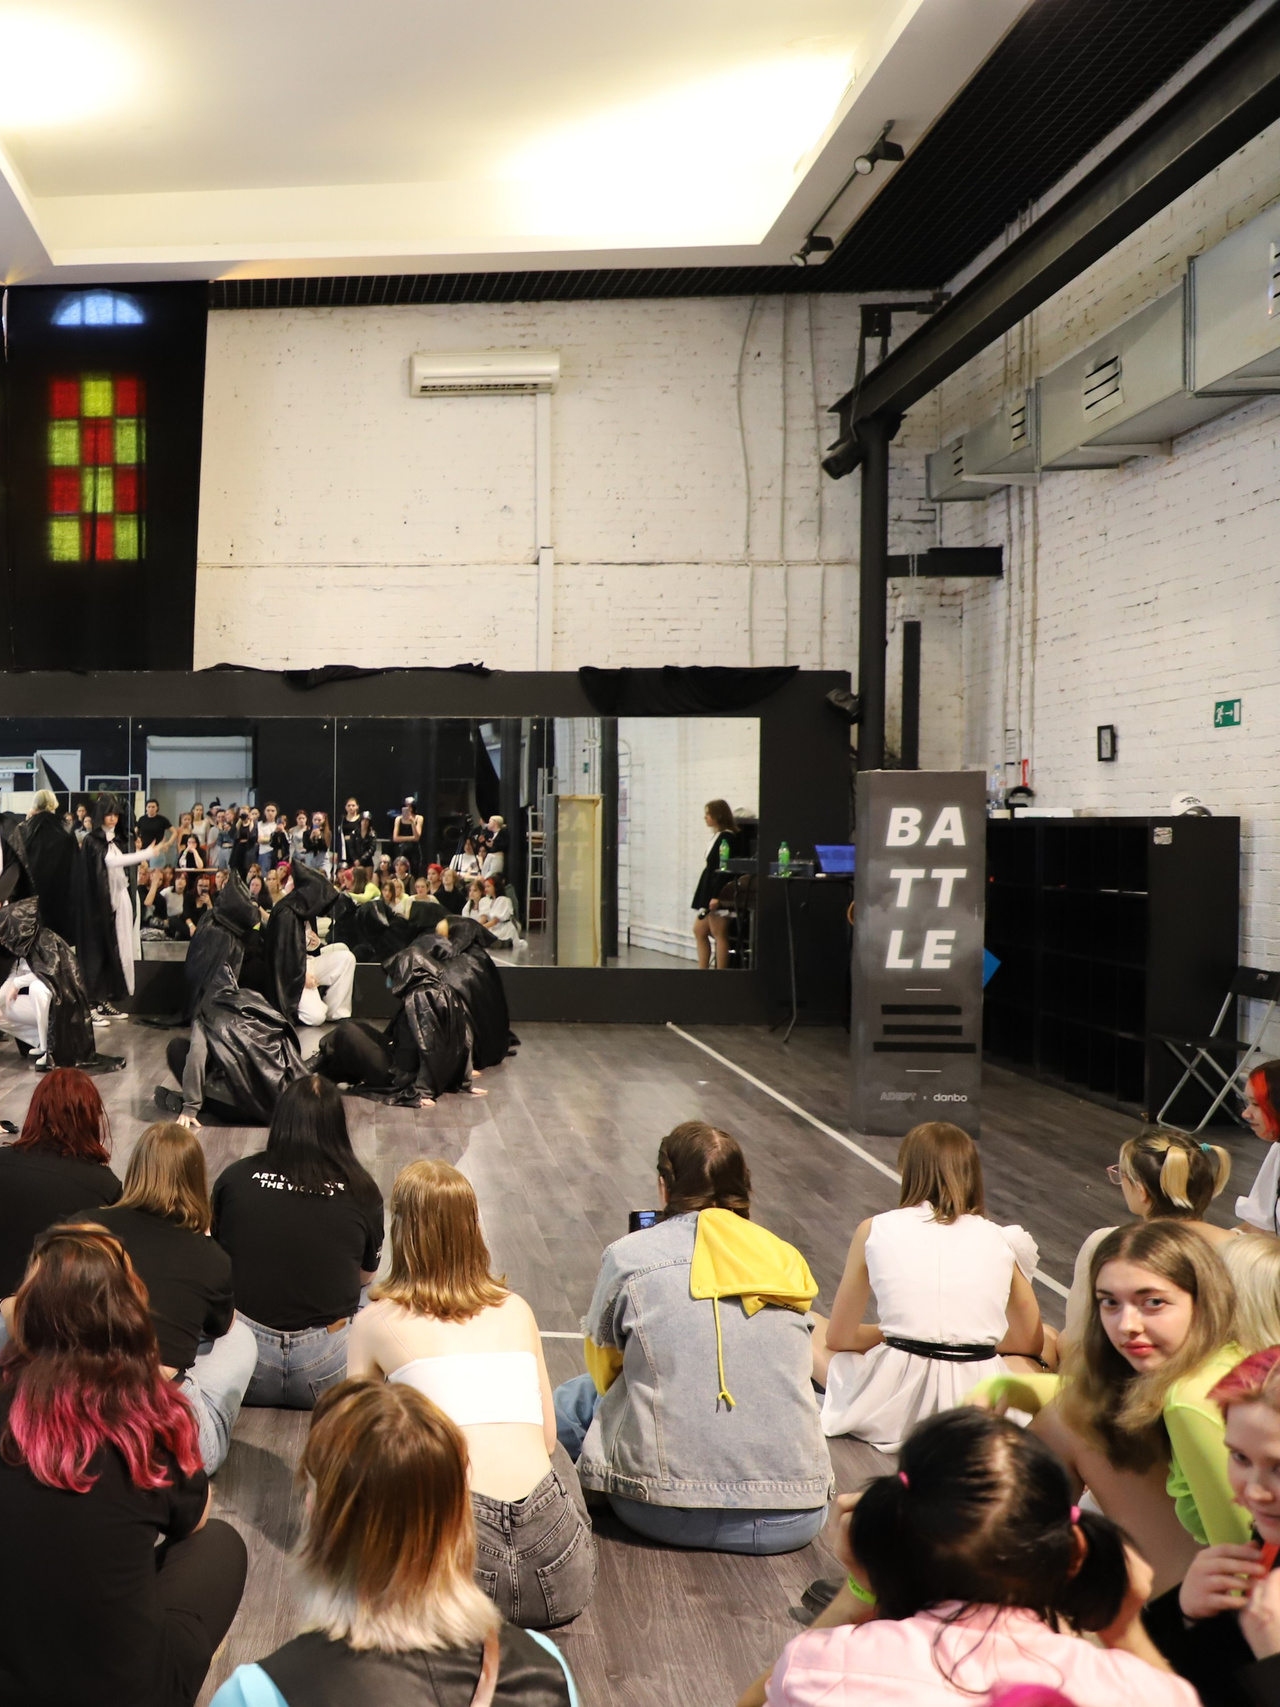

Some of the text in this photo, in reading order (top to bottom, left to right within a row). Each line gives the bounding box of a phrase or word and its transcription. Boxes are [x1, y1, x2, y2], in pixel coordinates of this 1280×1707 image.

[886, 807, 966, 847] BA
[888, 869, 967, 908] TT
[885, 930, 956, 969] LE
[933, 1092, 967, 1102] danbo
[252, 1172, 277, 1181] ART
[260, 1179, 284, 1190] THE
